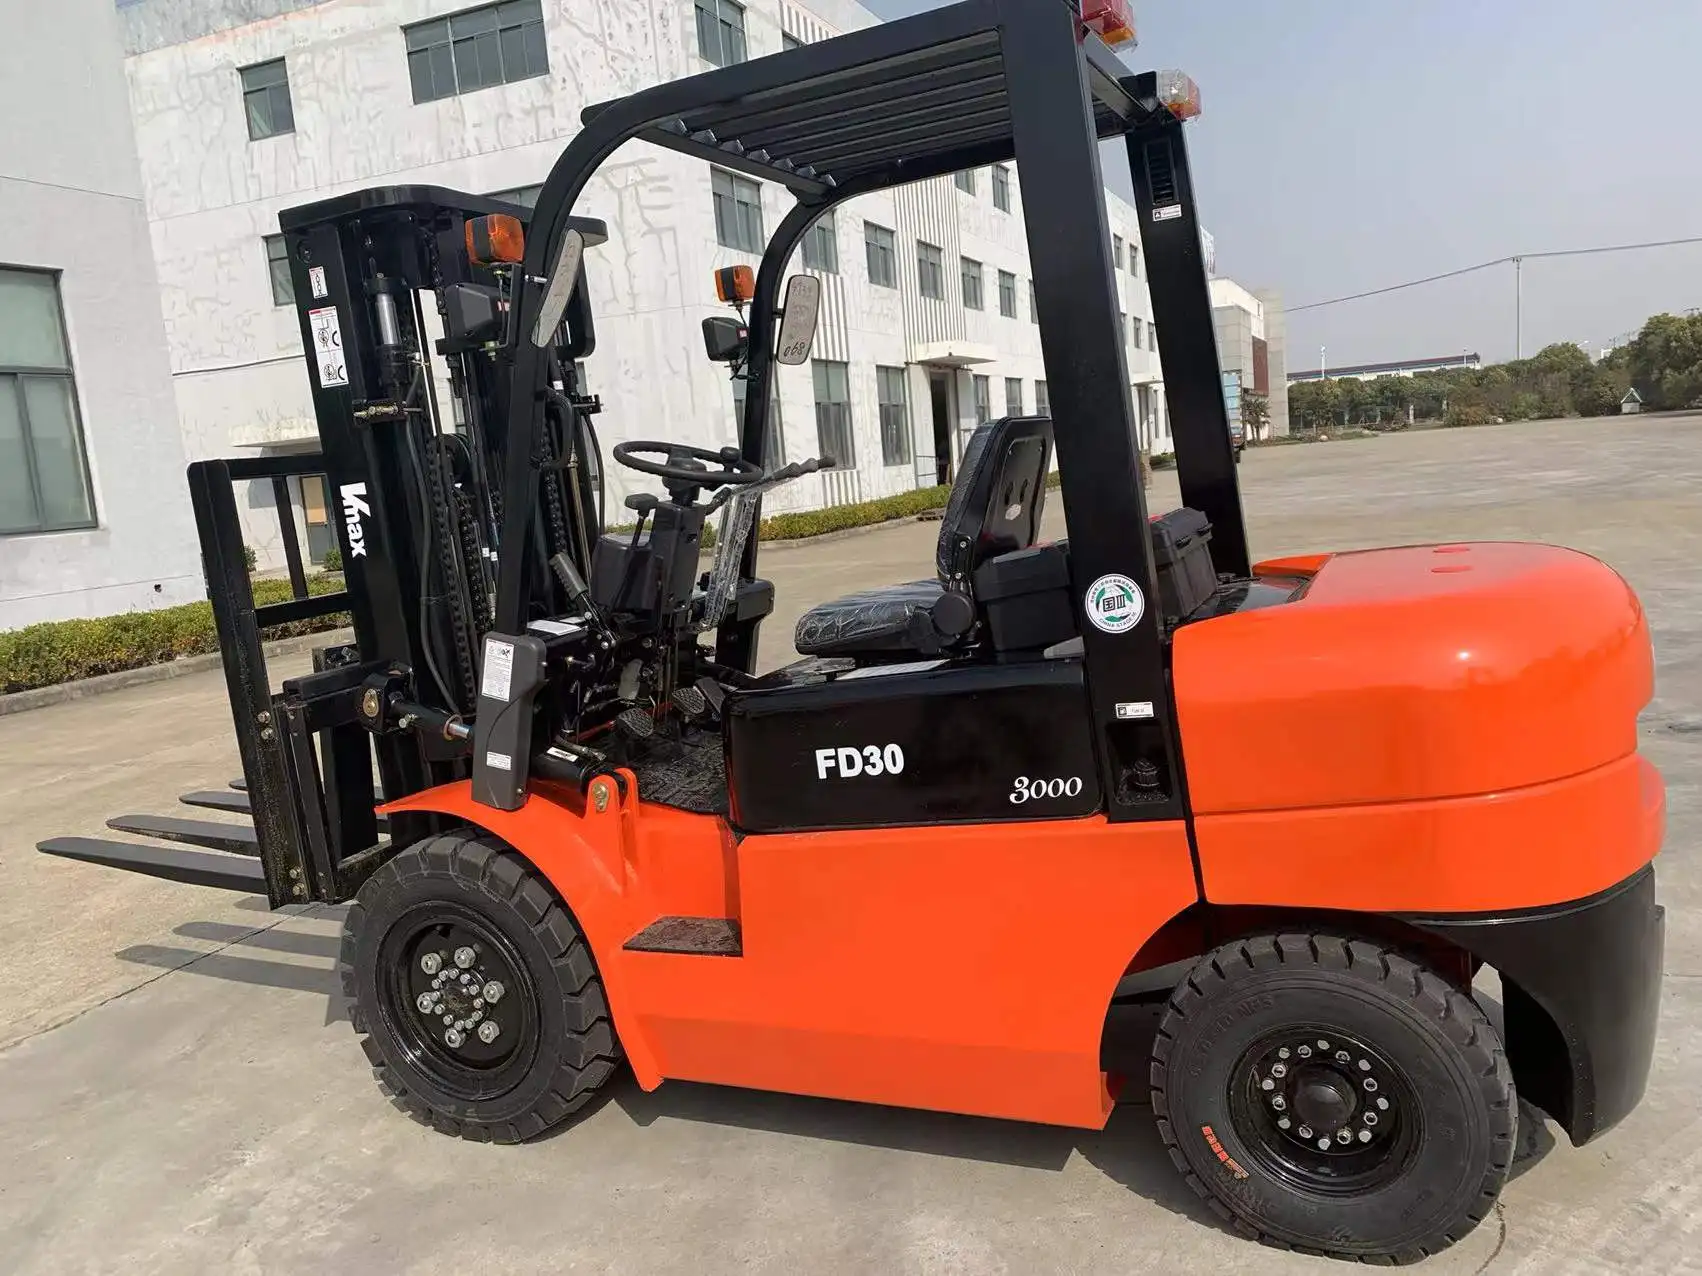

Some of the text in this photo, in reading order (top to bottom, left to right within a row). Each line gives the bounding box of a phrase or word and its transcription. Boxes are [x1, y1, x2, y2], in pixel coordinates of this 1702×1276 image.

[340, 482, 371, 558] Vmax
[815, 743, 905, 780] FD30
[1009, 776, 1083, 804] 3000
